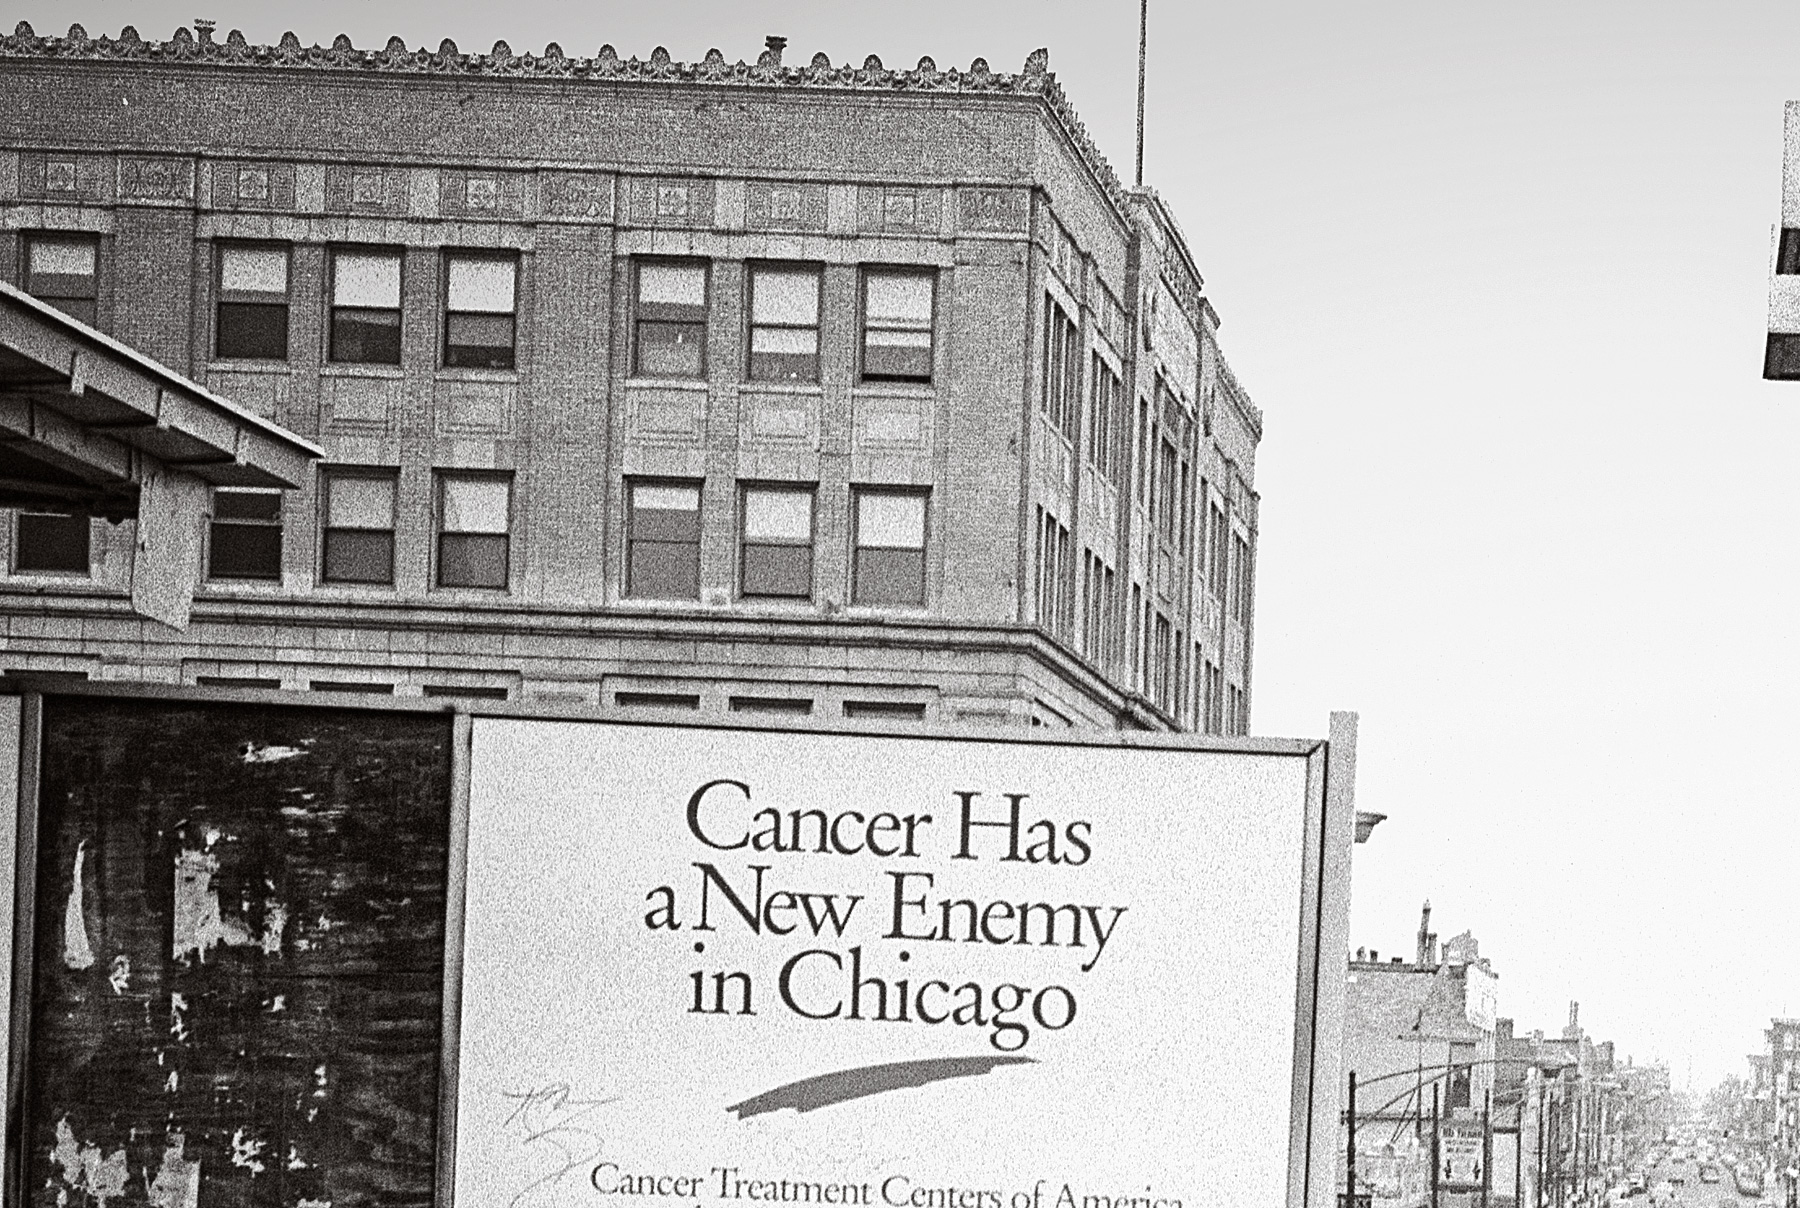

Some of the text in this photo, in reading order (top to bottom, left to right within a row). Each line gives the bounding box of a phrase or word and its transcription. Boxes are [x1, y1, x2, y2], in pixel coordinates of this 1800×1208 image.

[686, 779, 1091, 865] Cancer Has
[644, 862, 1127, 973] a New Enemy
[689, 942, 1077, 1051] in Chicago
[590, 1162, 704, 1197] Cancer
[712, 1166, 871, 1205] Treatment
